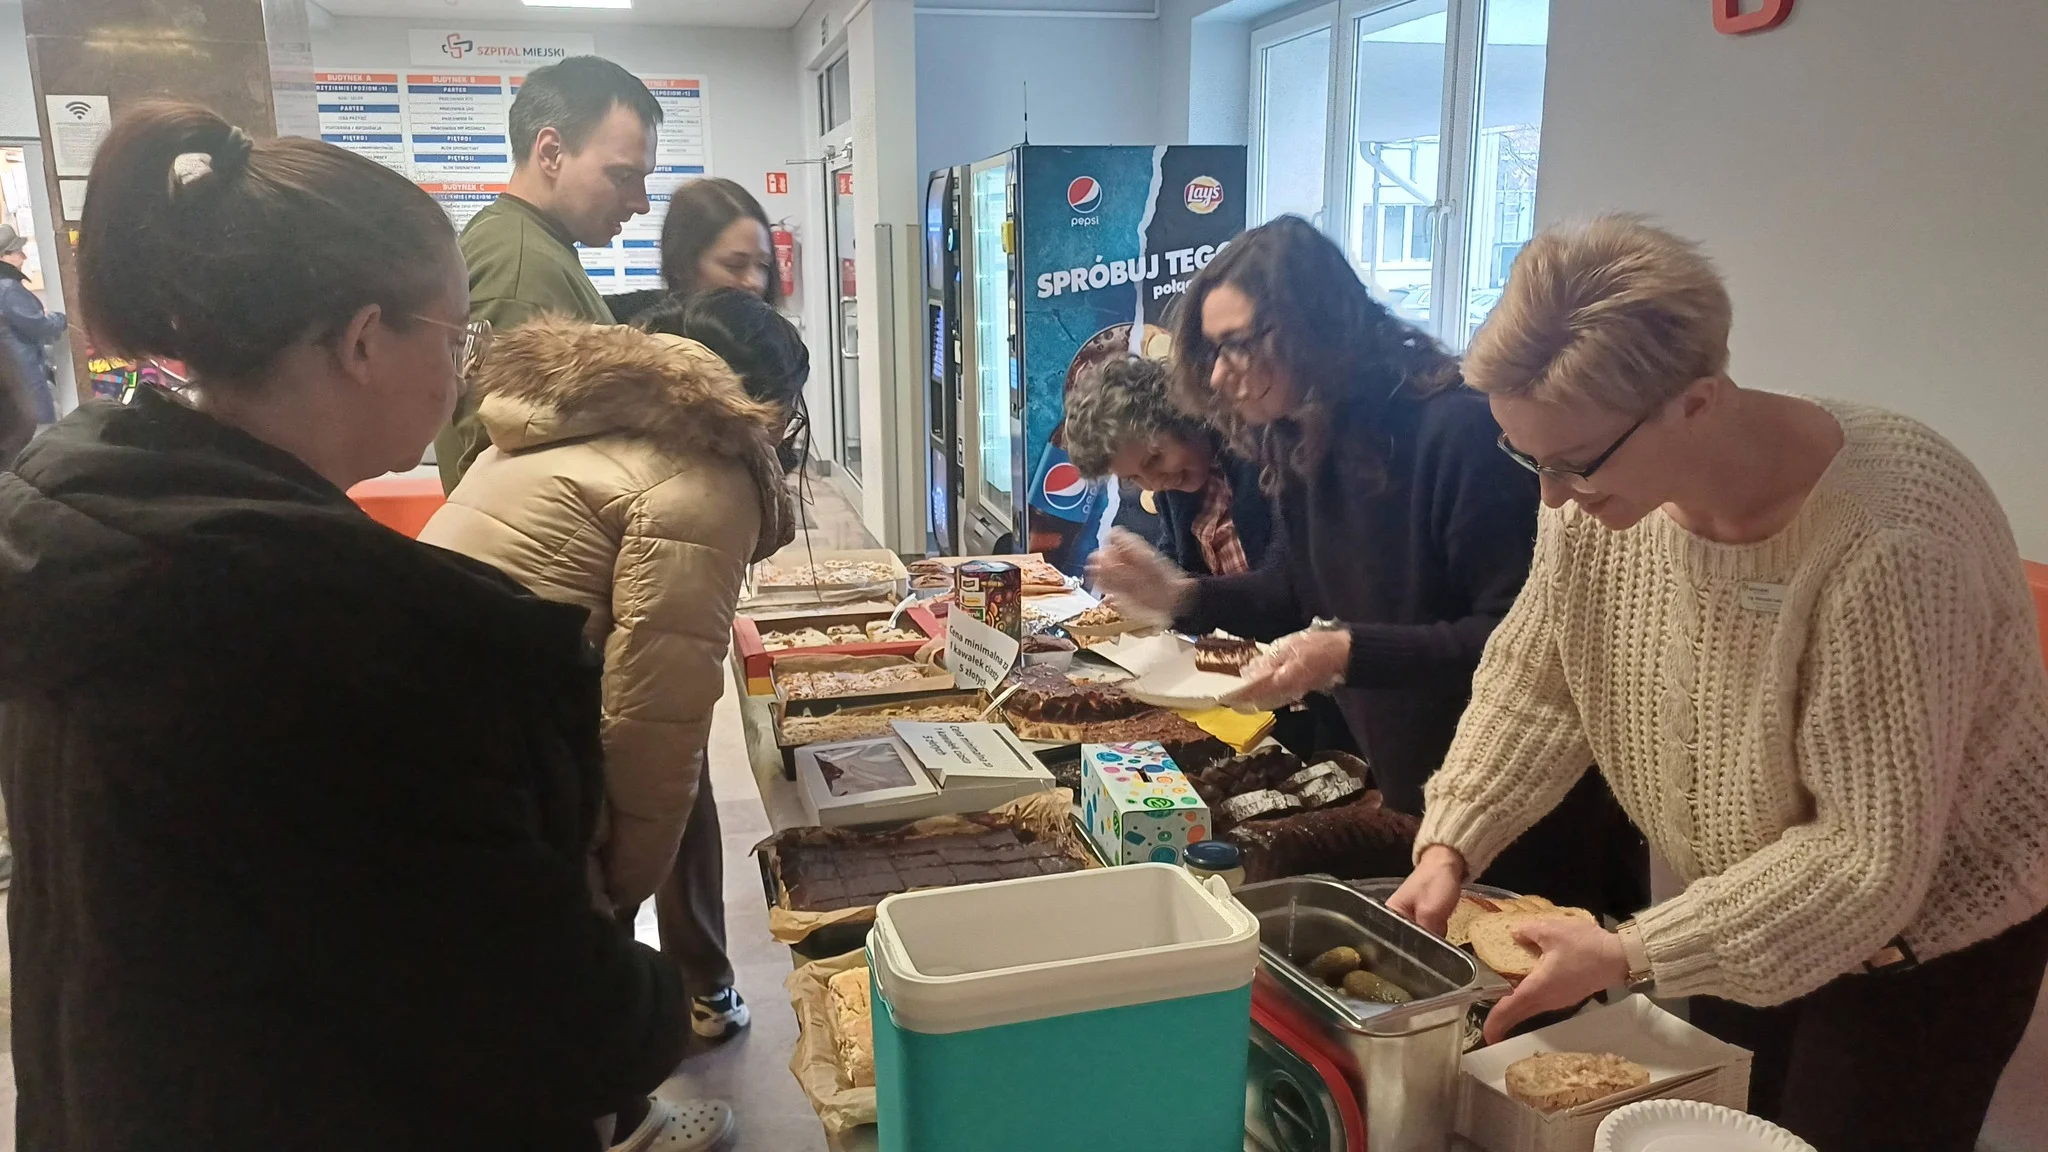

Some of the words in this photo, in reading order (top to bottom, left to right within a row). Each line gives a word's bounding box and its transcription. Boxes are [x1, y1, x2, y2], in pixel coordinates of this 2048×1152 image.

[477, 46, 520, 57] SZPITAL
[523, 48, 565, 57] MIEJSKI
[432, 75, 467, 83] BUDYNEK
[442, 183, 477, 191] BUDYNEK
[1070, 215, 1100, 227] pepsi
[1037, 254, 1160, 299] SPRÓBUJ
[949, 625, 964, 642] Cena
[964, 638, 1004, 666] minimalna
[1002, 661, 1009, 671] za
[953, 644, 985, 669] kawałek
[958, 663, 964, 673] 5
[965, 668, 987, 686] złotych
